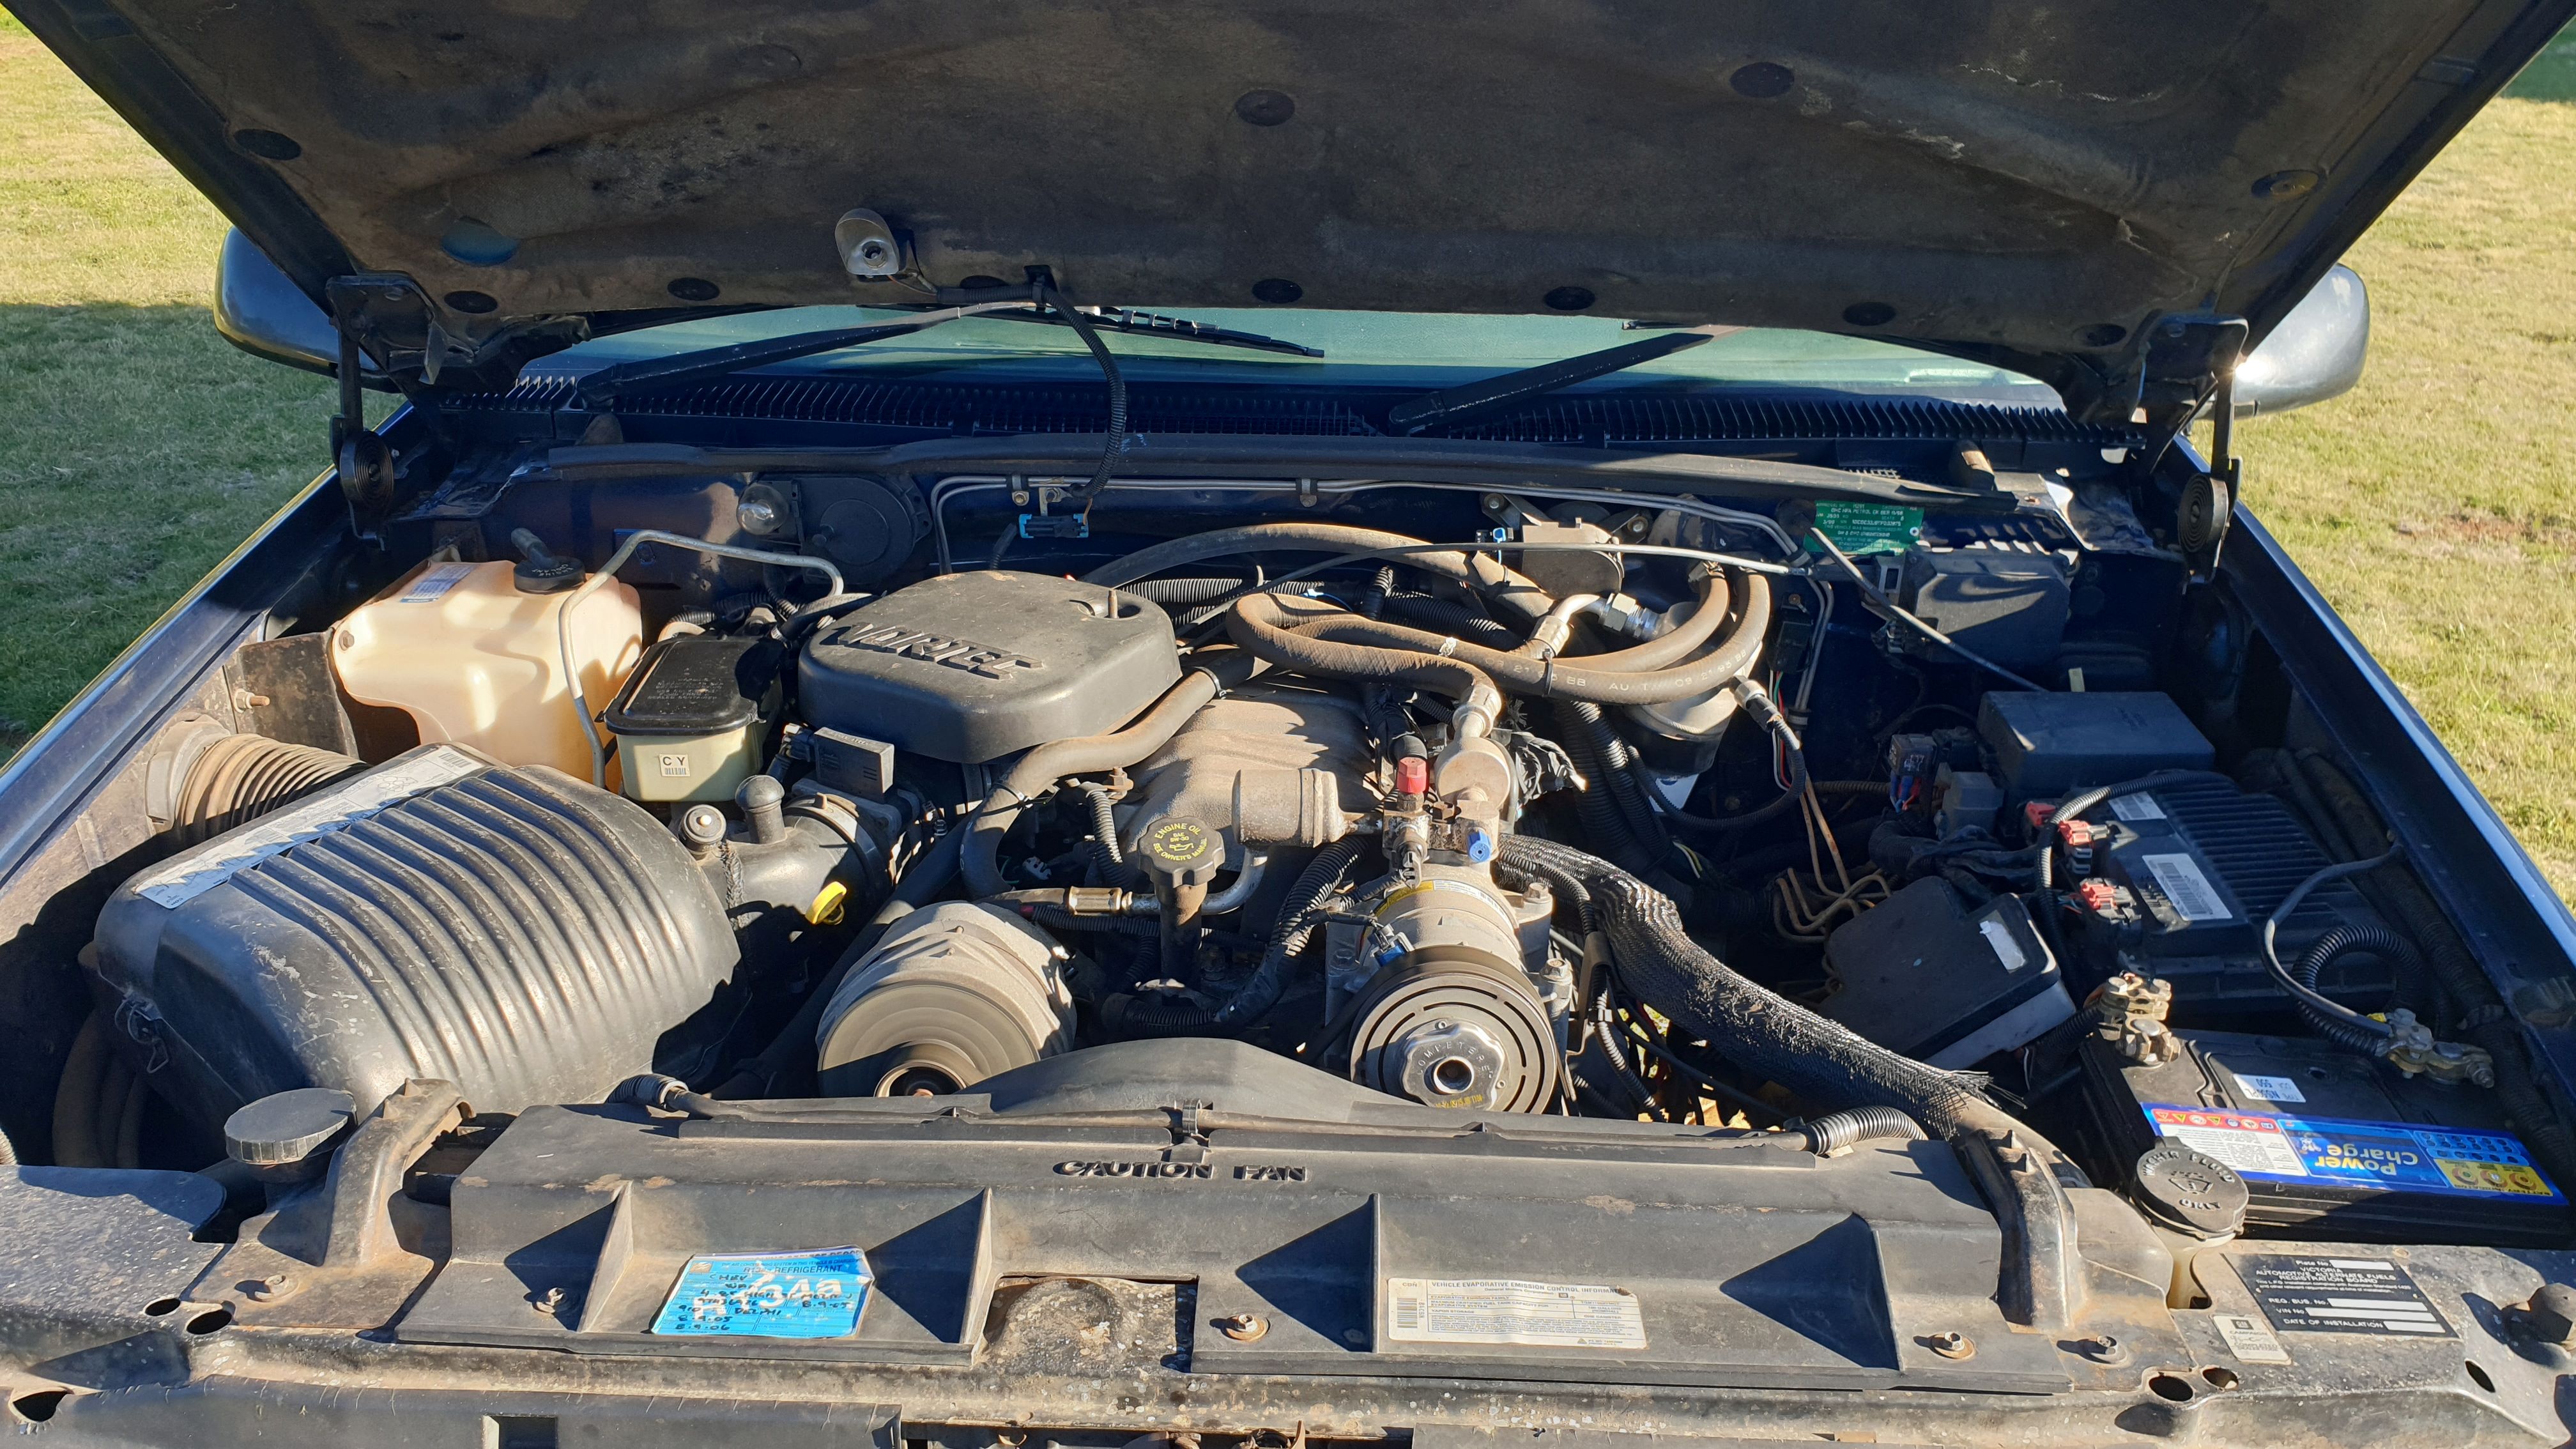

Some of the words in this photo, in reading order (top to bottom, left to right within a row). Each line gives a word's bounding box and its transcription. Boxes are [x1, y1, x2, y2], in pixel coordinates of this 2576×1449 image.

[836, 622, 1045, 680] VORTEC
[1154, 823, 1188, 839] ENGINE
[1188, 825, 1202, 836] OIL
[1153, 843, 1162, 854] SEE
[1191, 838, 1208, 858] MANUAL
[2326, 1143, 2419, 1165] Charge
[1057, 1160, 1215, 1179] CAUTION
[1238, 1165, 1308, 1183] FAN
[2189, 1153, 2235, 1183] FLUID
[2314, 1155, 2397, 1176] Power
[2179, 1198, 2222, 1209] ONLY
[774, 1264, 843, 1273] REFRIGERANT
[2255, 1269, 2311, 1278] AUTOMOTIVE
[1510, 1282, 1545, 1291] EMISSION
[2322, 1320, 2384, 1328] INSTALLATION
